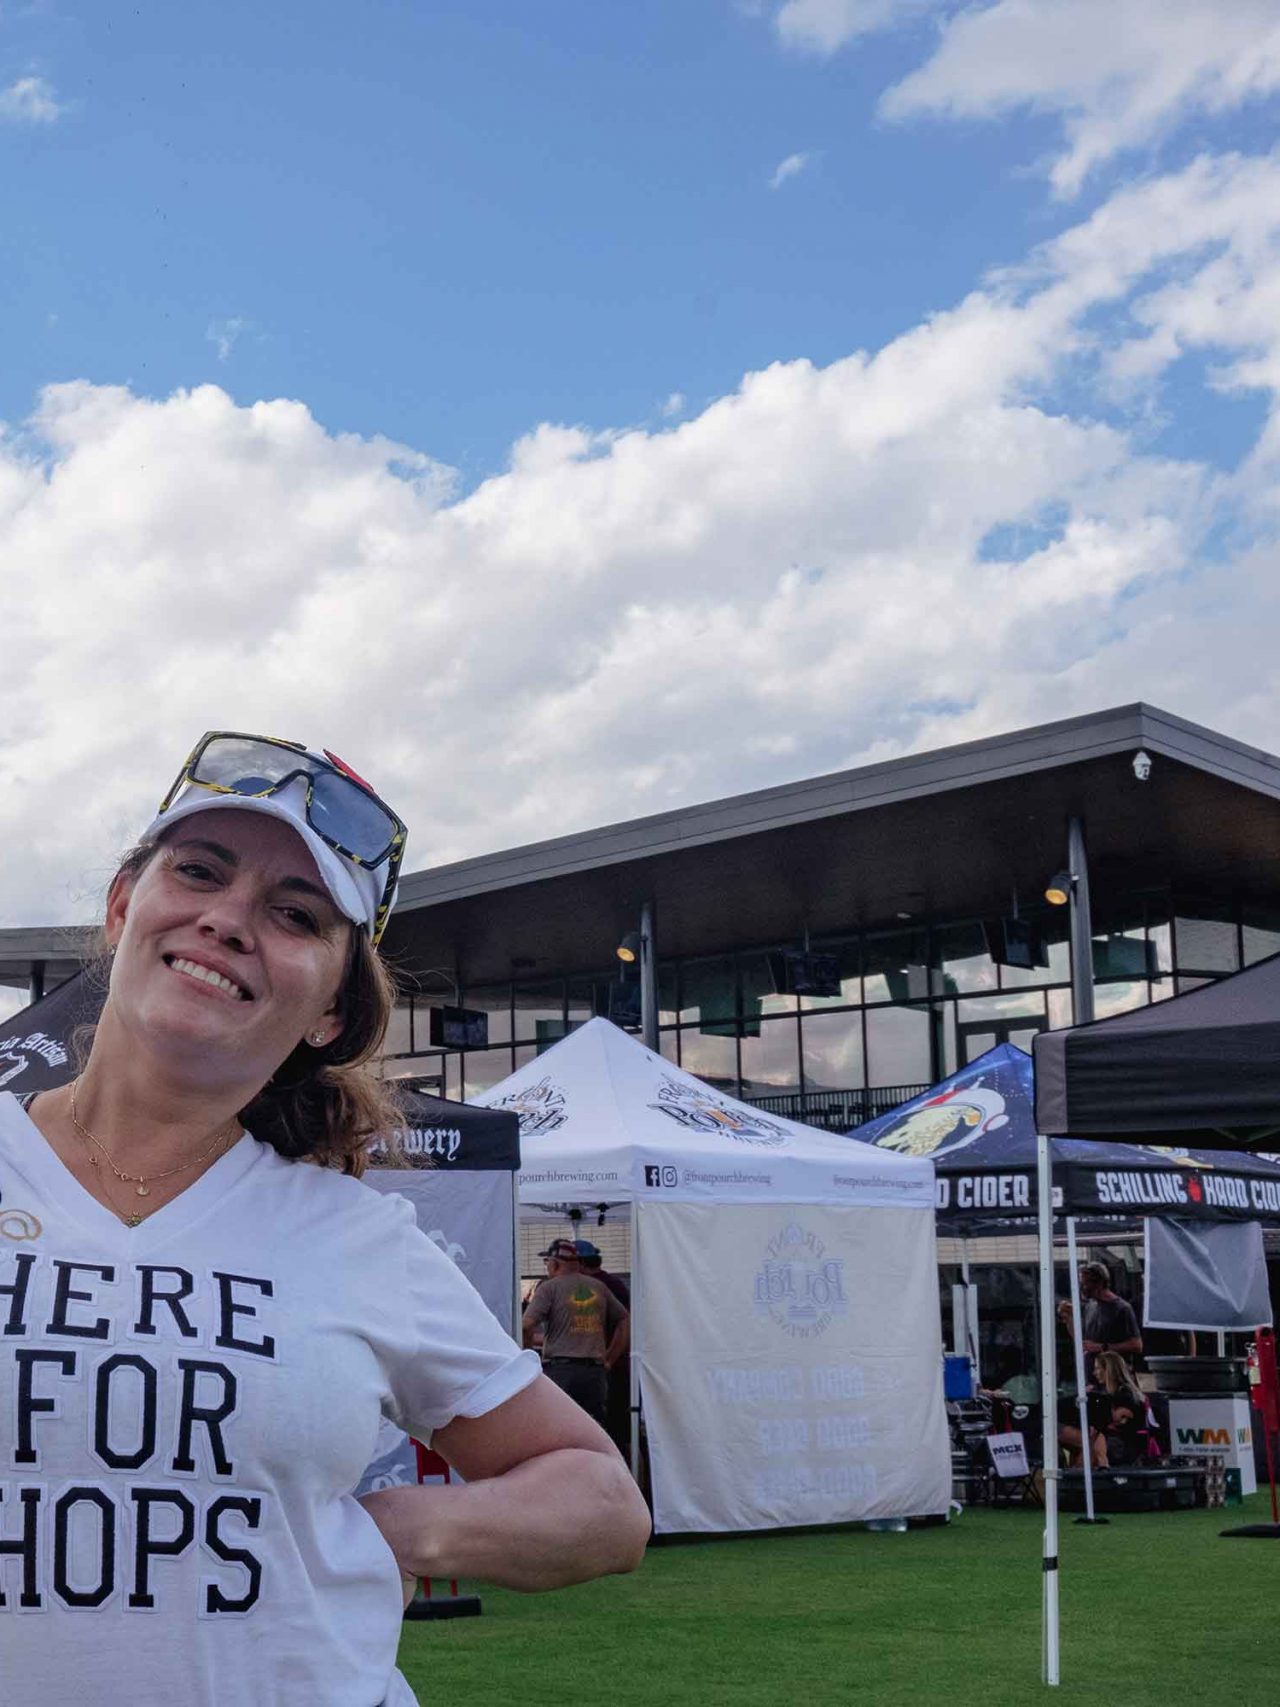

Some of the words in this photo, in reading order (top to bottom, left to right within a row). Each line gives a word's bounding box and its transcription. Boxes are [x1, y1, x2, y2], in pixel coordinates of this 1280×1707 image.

[19, 1032, 68, 1067] Artisan
[957, 1175, 1030, 1208] CIDER
[1096, 1172, 1188, 1204] SCHILLING
[1203, 1175, 1250, 1208] HARD
[15, 1349, 238, 1476] FOR
[1176, 1428, 1231, 1445] WM
